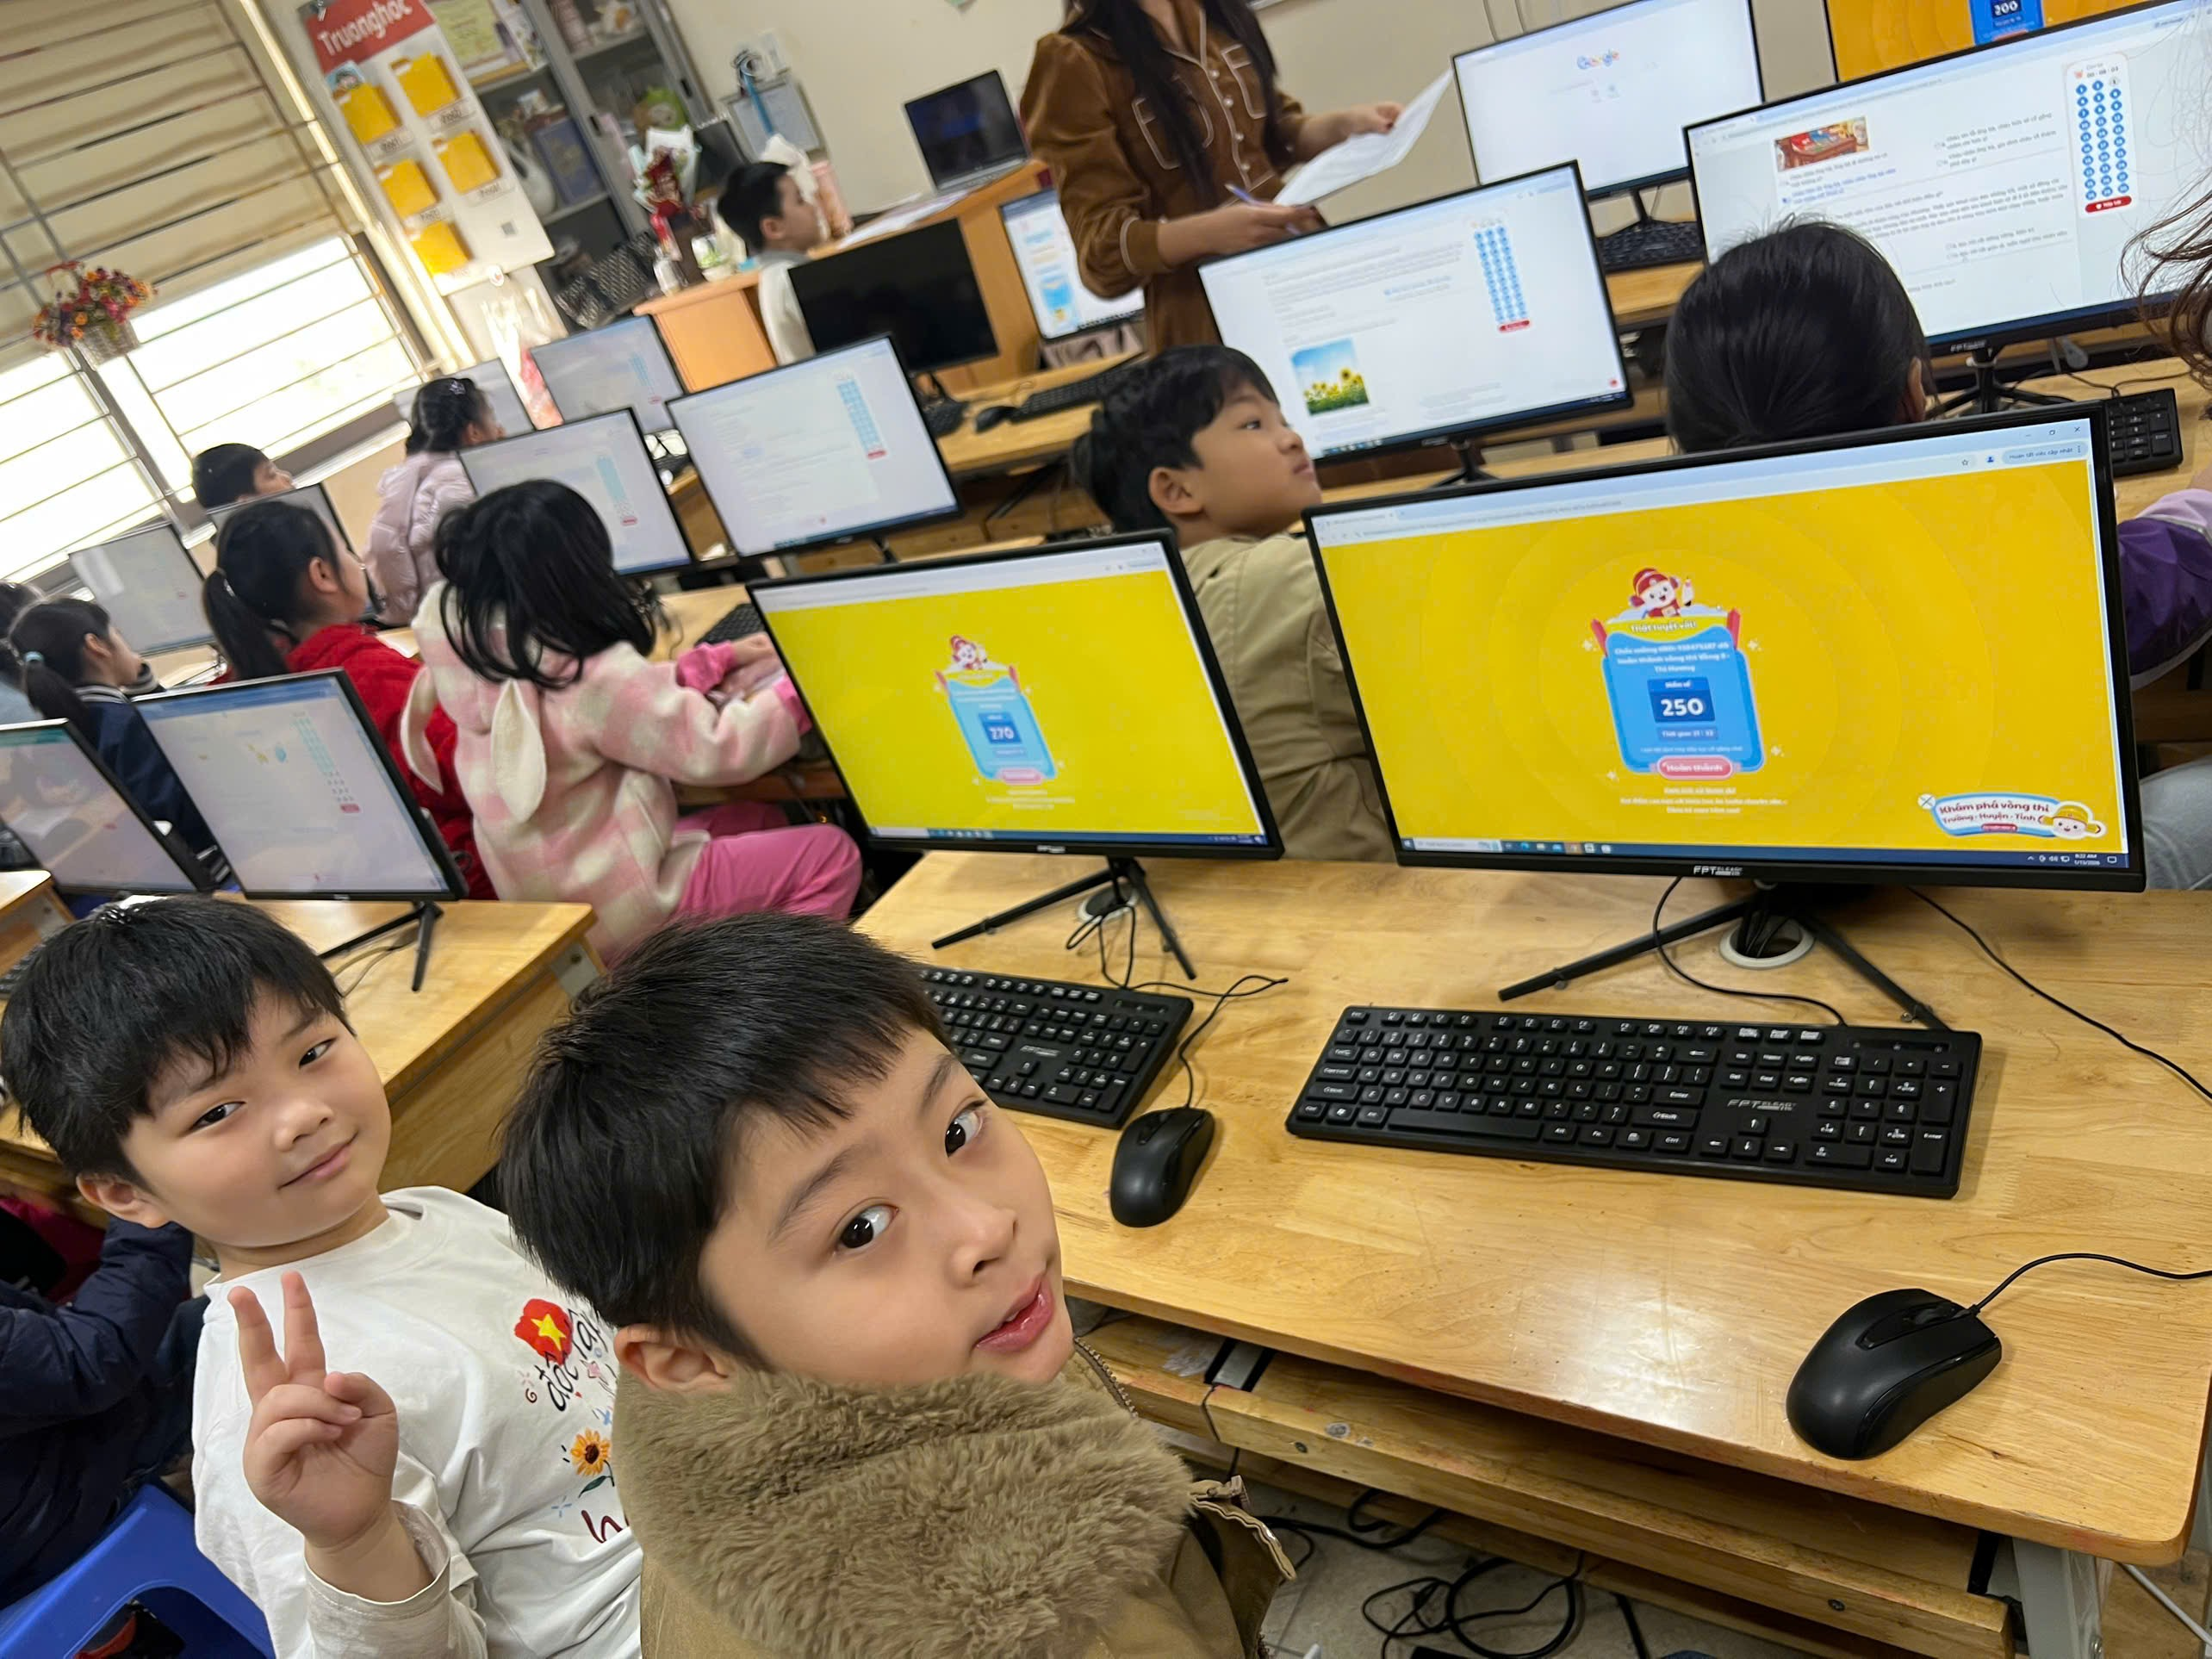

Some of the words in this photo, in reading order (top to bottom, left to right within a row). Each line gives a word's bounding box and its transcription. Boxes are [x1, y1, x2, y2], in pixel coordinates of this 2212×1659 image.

[1660, 698, 1704, 717] 250
[1940, 802, 1973, 813] Khám
[1976, 800, 1998, 811] phá
[2001, 800, 2030, 811] vòng
[2033, 803, 2049, 812] thi
[1693, 866, 1717, 875] FPT
[1727, 1099, 1762, 1109] FPT
